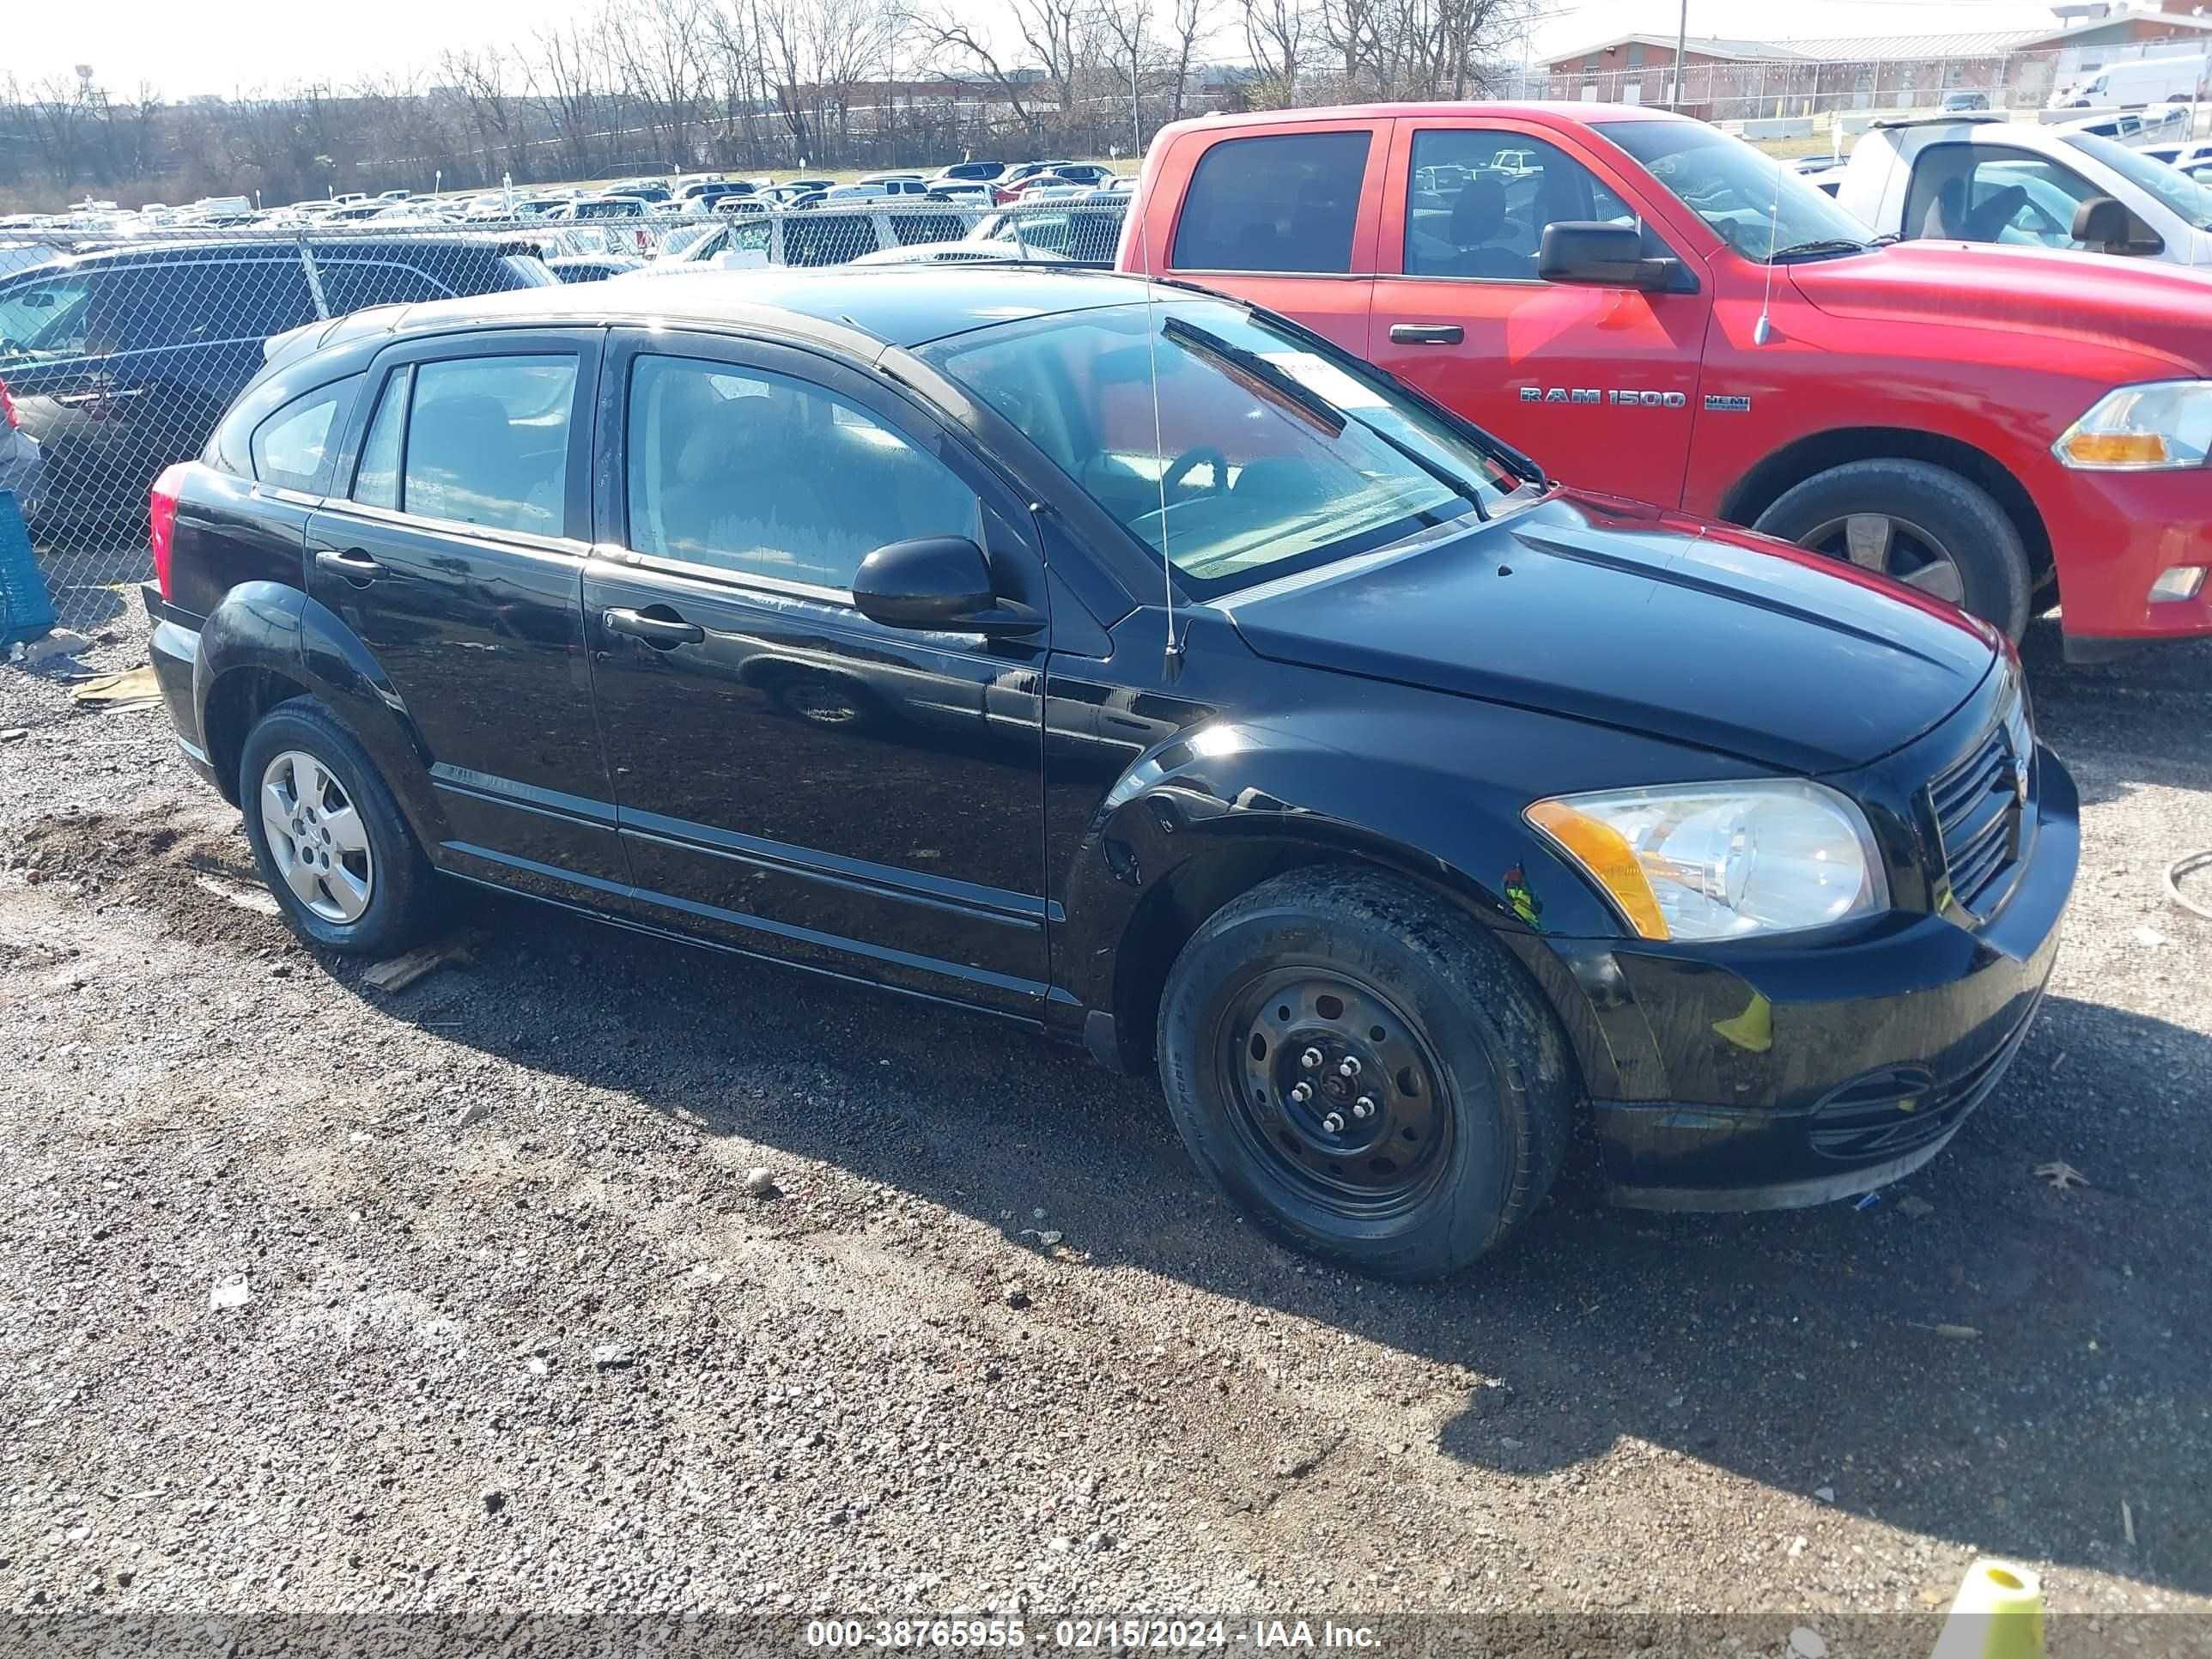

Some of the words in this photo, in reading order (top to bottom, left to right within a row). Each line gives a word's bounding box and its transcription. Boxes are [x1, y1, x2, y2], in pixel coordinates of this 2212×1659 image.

[1520, 386, 1601, 405] RAM
[1608, 389, 1686, 408] 1500
[1705, 395, 1750, 407] HEMI
